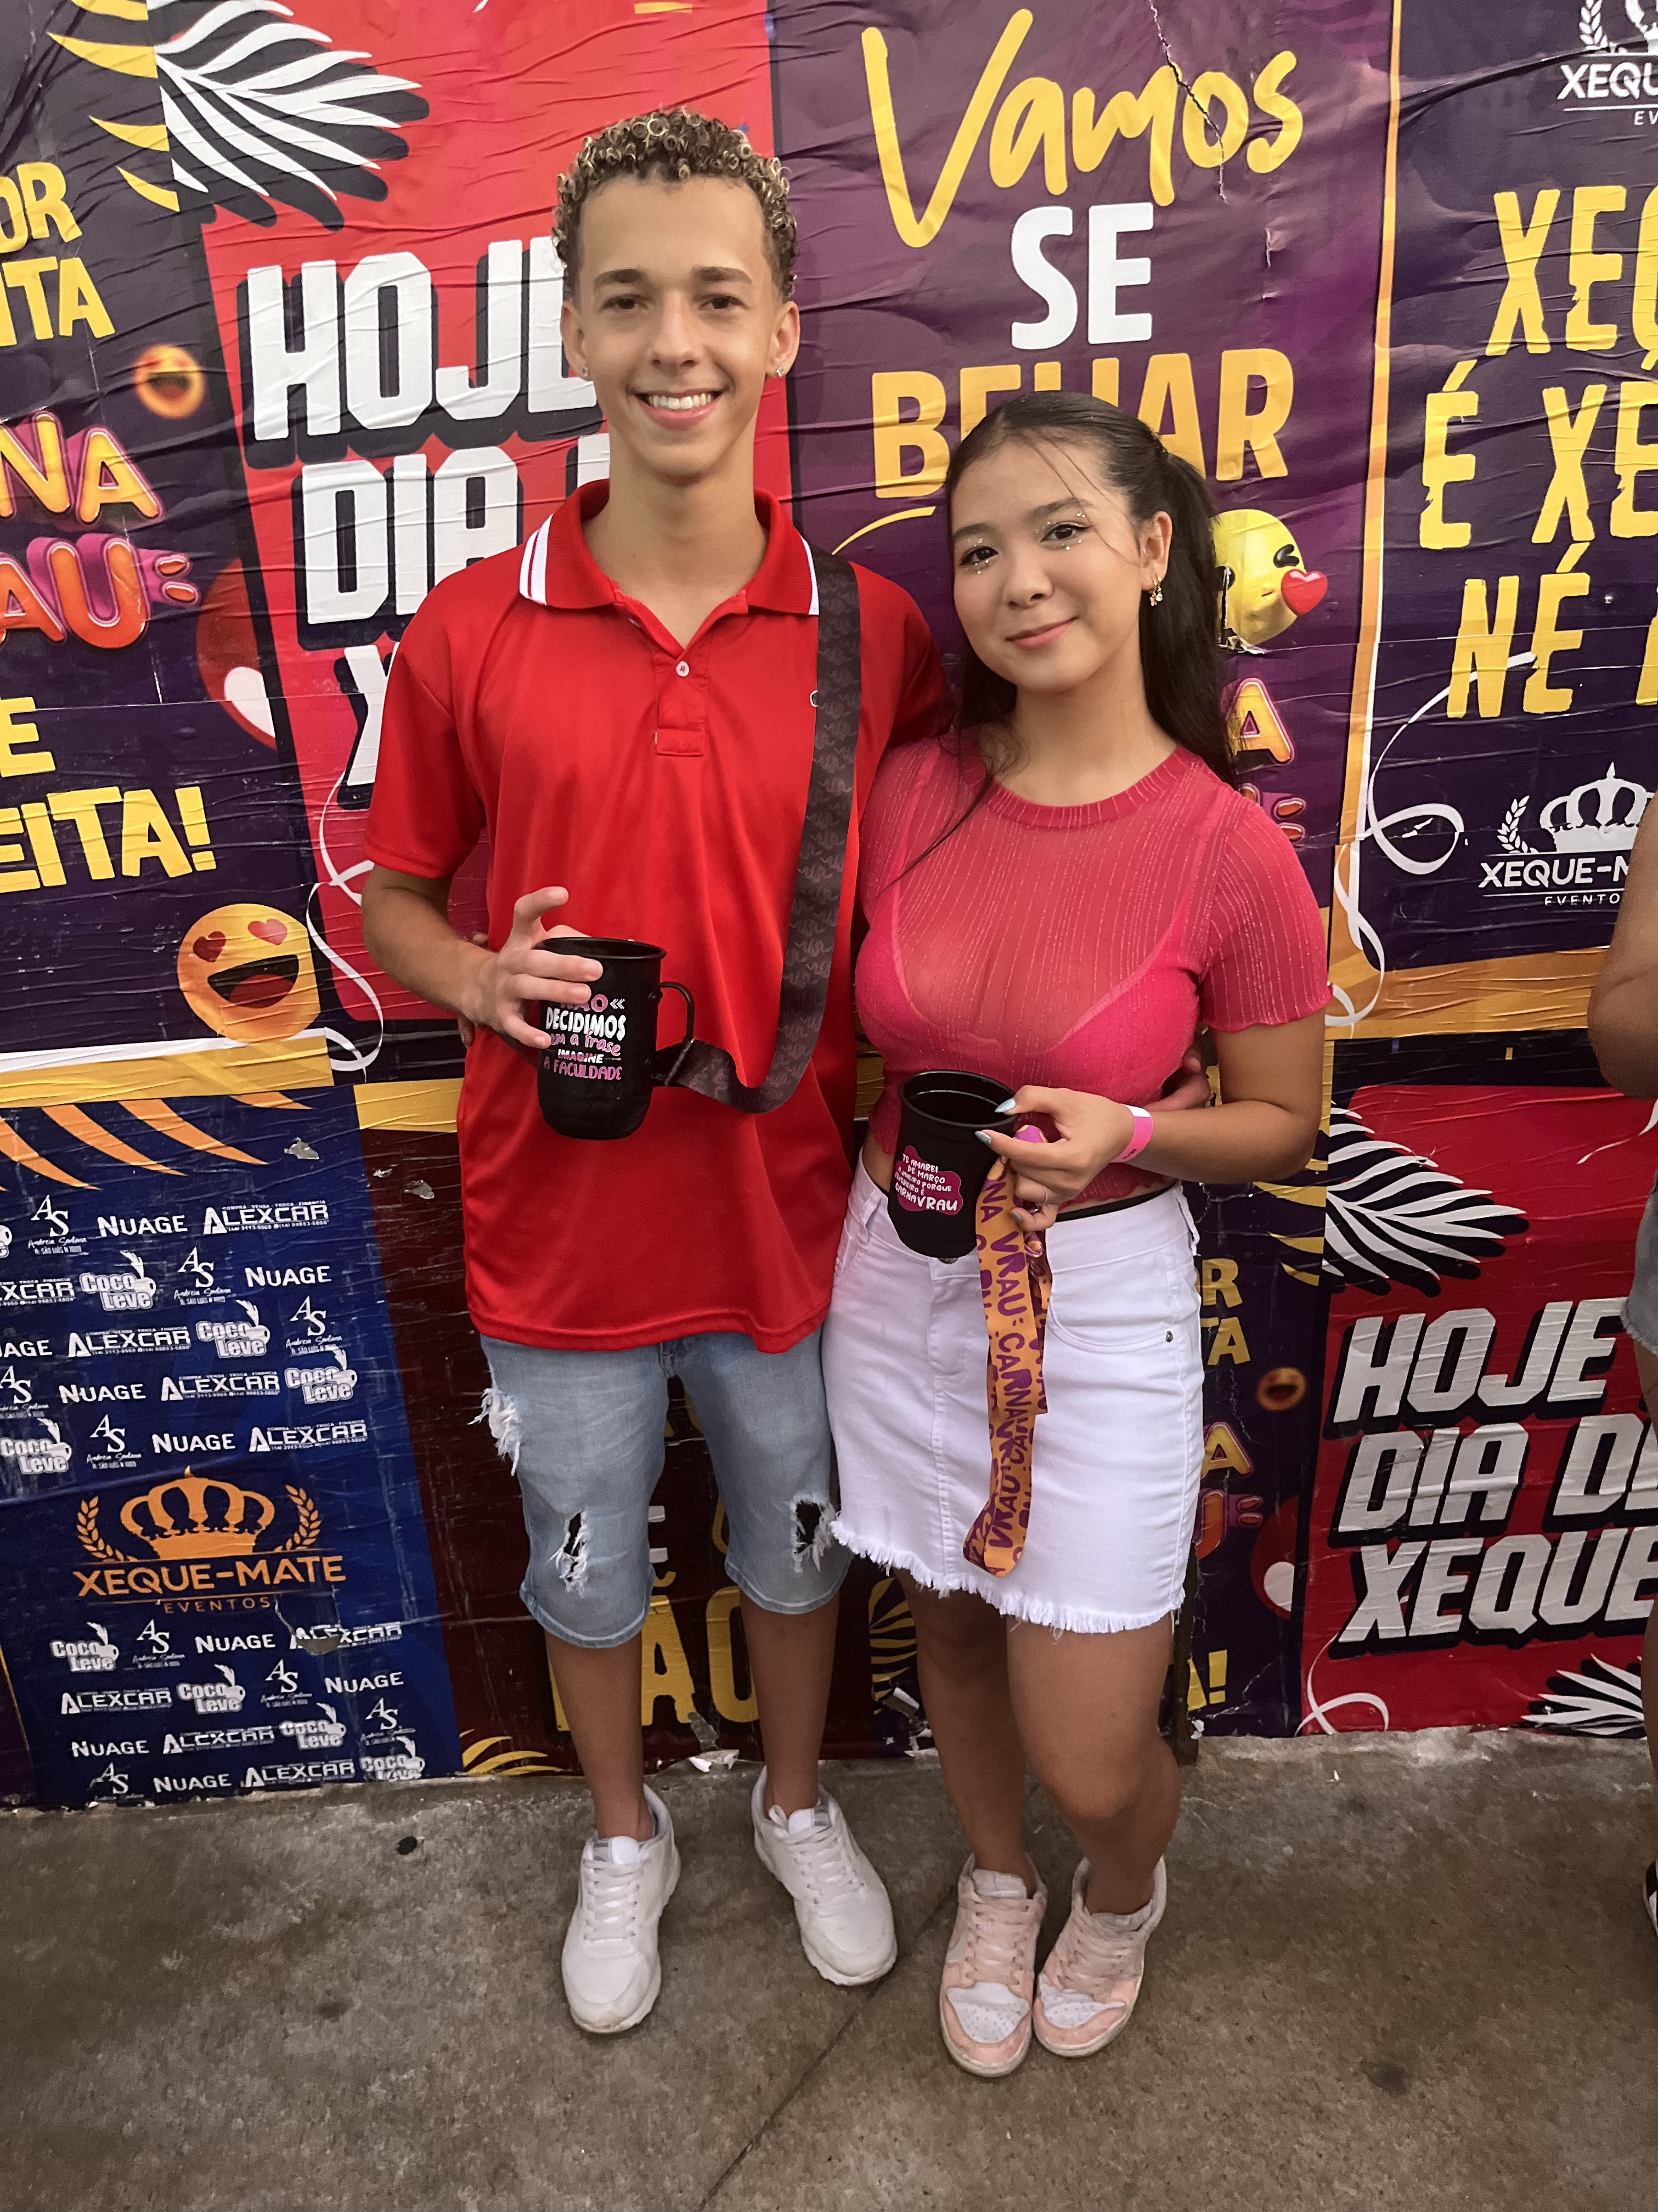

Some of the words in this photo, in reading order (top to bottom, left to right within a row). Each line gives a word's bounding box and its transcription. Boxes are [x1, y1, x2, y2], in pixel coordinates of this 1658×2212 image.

[861, 9, 1303, 248] Vamos
[1011, 202, 1154, 349] SE
[1420, 359, 1479, 549] É
[302, 445, 517, 624] DIA
[1447, 542, 1590, 718] NÉ
[545, 1007, 627, 1041] DECIDIMOS
[558, 1048, 605, 1063] IMAGINE
[570, 1034, 579, 1046] a
[585, 1029, 621, 1056] frase
[554, 1059, 623, 1080] FACULDADE
[903, 1153, 909, 1163] TE
[911, 1159, 938, 1173] AMAREI
[907, 1165, 916, 1174] DE
[917, 1170, 945, 1184] MARÇO
[922, 1182, 952, 1192] PORQUE
[97, 1215, 188, 1237] NUAGE
[203, 1205, 329, 1234] ALEXCAR
[80, 1273, 137, 1294] Coco
[245, 1266, 332, 1287] NUAGE
[101, 1291, 153, 1311] Leve
[69, 1330, 191, 1357] ALEXCAR
[196, 1321, 252, 1341] Coco
[215, 1339, 267, 1358] Leve
[1333, 1298, 1628, 1423] HOJE
[59, 1384, 146, 1404] NUAGE
[161, 1375, 280, 1401] ALEXCAR
[284, 1366, 339, 1388] Coco
[302, 1384, 353, 1404] Leve
[0, 1438, 50, 1457] Coco
[152, 1434, 236, 1453] NUAGE
[249, 1423, 368, 1452] ALEXCAR
[19, 1455, 68, 1475] Leve
[1338, 1422, 1529, 1532] DIA
[73, 1555, 346, 1597] XEQUE-MATE
[1339, 1525, 1658, 1643] XEQUE
[165, 1596, 270, 1615] EVENTOS
[50, 1641, 99, 1658] Coco
[195, 1634, 275, 1654] NUAGE
[67, 1656, 116, 1672] Leve
[61, 1691, 172, 1714] ALEXCAR
[177, 1683, 227, 1700] Coco
[325, 1672, 404, 1693] NUAGE
[195, 1698, 243, 1715] Leve
[71, 1740, 150, 1757] NUAGE
[163, 1730, 274, 1754] ALEXCAR
[279, 1720, 330, 1737] Coco
[153, 1774, 232, 1793] NUAGE
[245, 1762, 355, 1787] ALEXCAR
